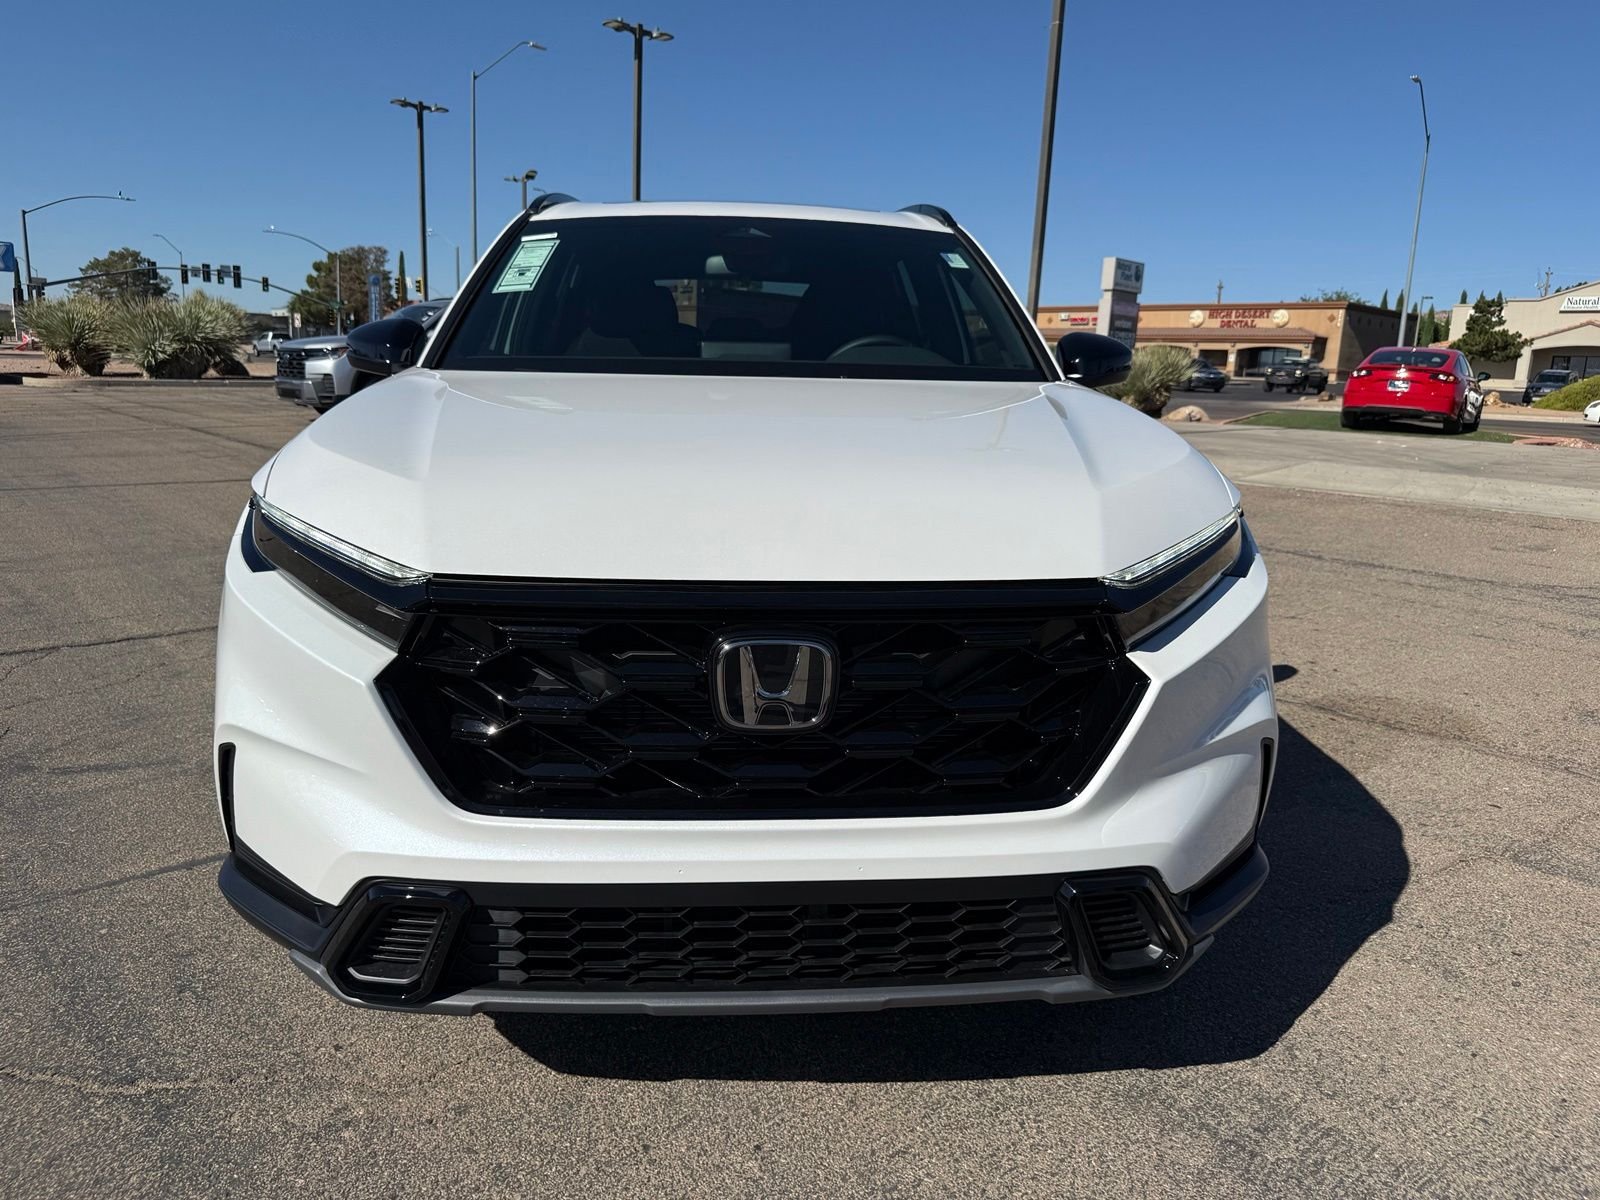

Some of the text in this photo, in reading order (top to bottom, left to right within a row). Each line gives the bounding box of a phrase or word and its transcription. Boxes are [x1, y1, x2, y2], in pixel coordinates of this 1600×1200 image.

[1567, 297, 1600, 306] Natural
[1208, 309, 1272, 320] HIGH DESERT
[1220, 320, 1257, 328] DENTAL
